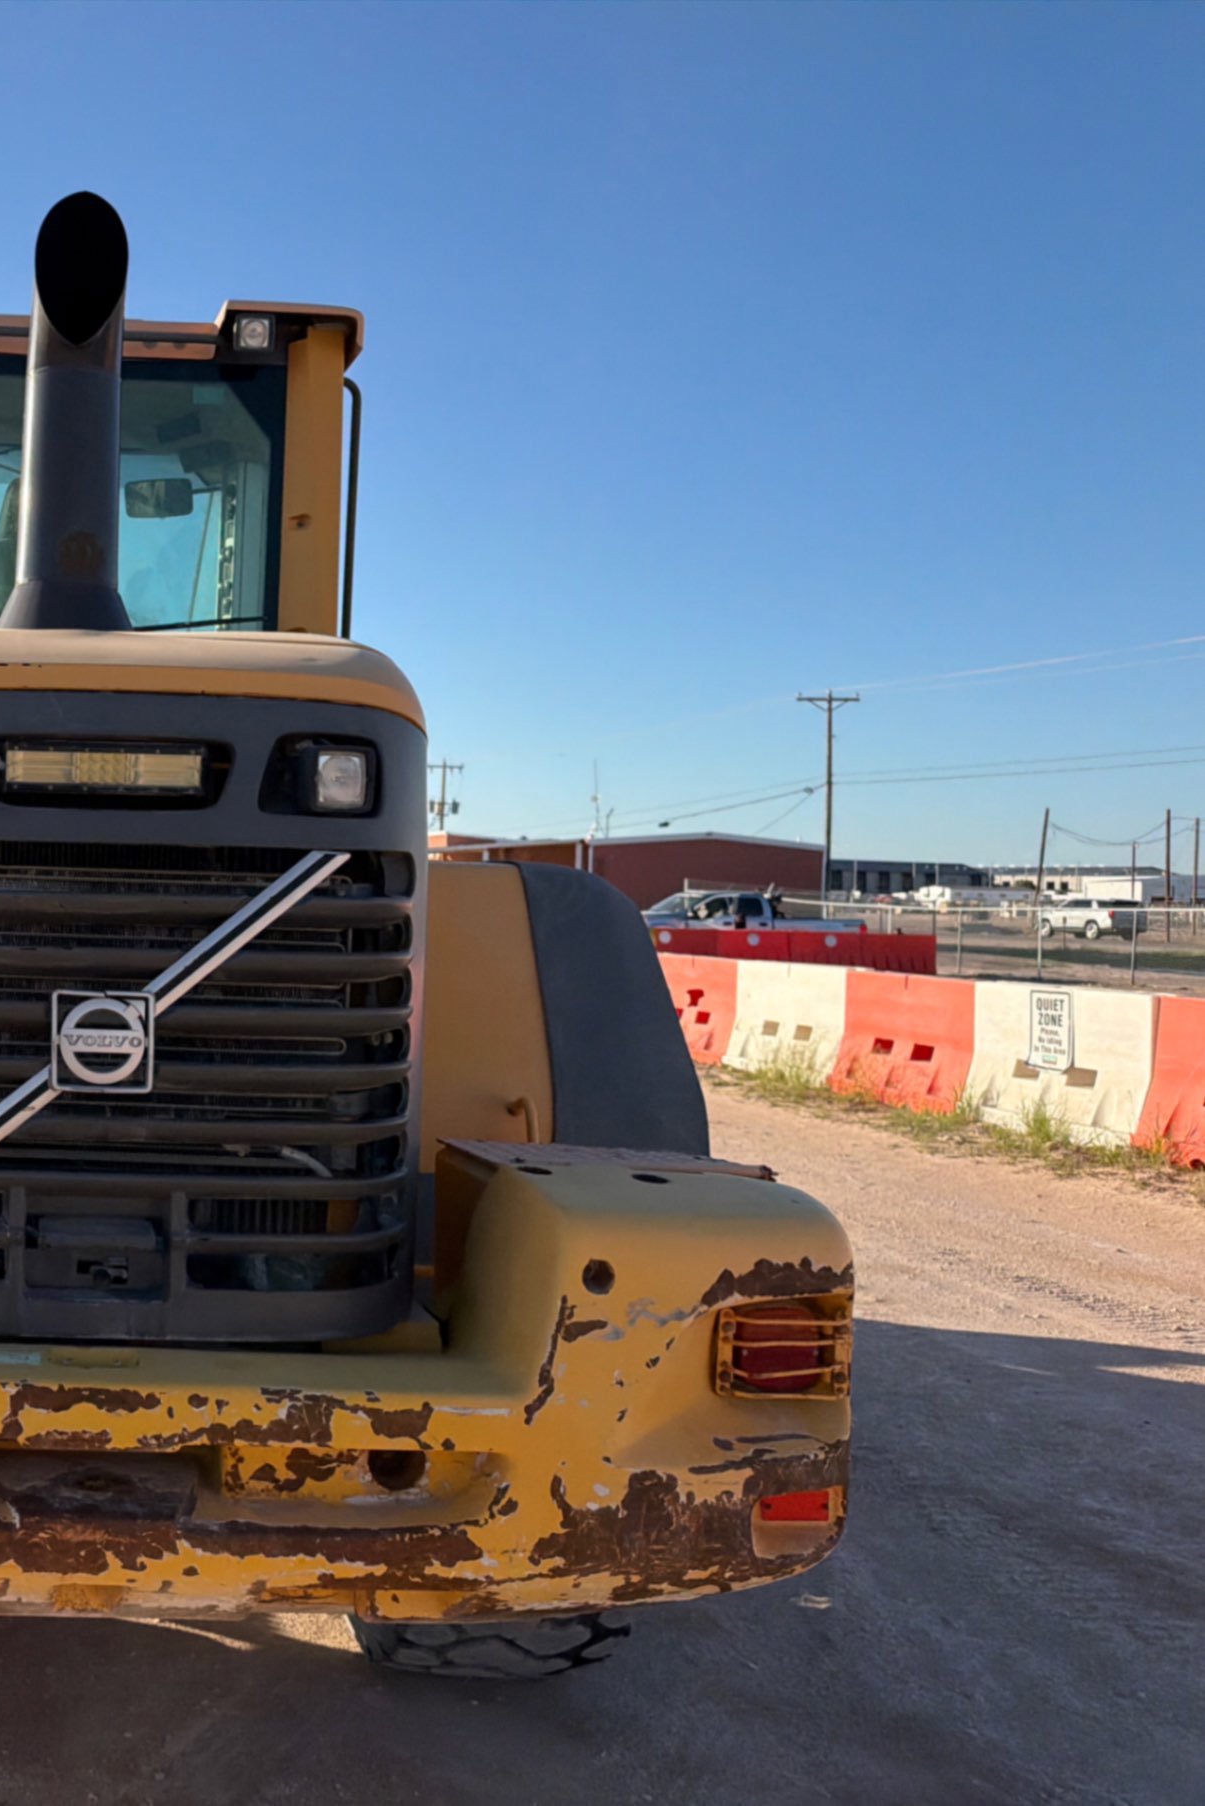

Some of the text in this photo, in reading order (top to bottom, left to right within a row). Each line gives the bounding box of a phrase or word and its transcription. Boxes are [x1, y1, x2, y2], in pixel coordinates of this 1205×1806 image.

[1036, 997, 1064, 1012] QUIET
[1038, 1013, 1063, 1027] ZONE
[63, 1034, 143, 1048] VOLVO
